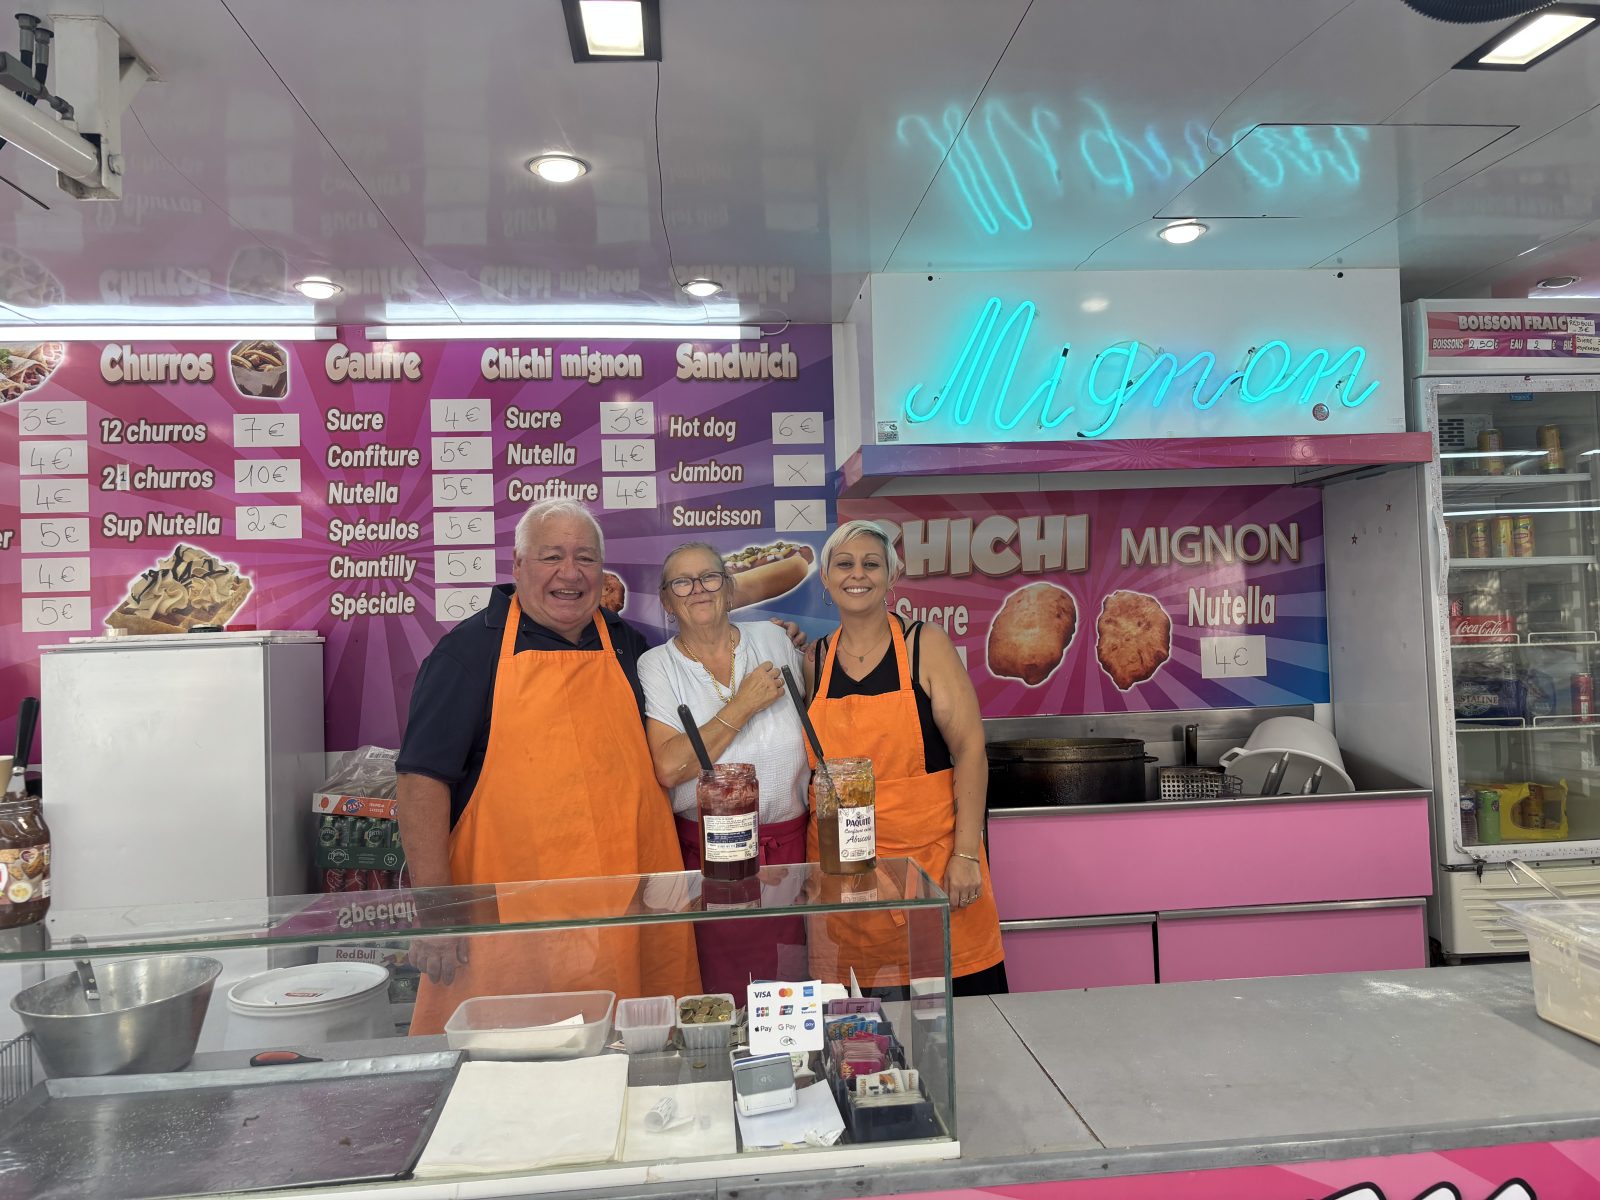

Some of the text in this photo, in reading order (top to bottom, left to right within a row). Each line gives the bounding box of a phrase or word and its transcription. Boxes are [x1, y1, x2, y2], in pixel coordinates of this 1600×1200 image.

[1458, 315, 1585, 331] BOISSON FRAIC
[1432, 338, 1464, 349] BOISSONS
[1510, 338, 1523, 350] EAU
[1563, 337, 1573, 351] BIE
[100, 343, 214, 382] Churros
[325, 343, 421, 382] Gaufre
[481, 345, 643, 384] Chichi mignon
[676, 343, 798, 380] Sandwich
[905, 296, 1380, 437] Mignon
[326, 408, 384, 431] Sucre
[506, 407, 562, 429] Sucre
[670, 416, 736, 442] Hot dog
[101, 420, 206, 443] 12 churros
[327, 446, 420, 468] Confiture
[507, 443, 575, 465] Nutella
[102, 464, 214, 490] 21 churros
[670, 461, 743, 483] Jambon
[328, 482, 398, 504] Nutella
[508, 479, 598, 501] Confiture
[103, 513, 220, 542] Sup Nutella
[672, 505, 762, 527] Saucisson
[329, 518, 419, 546] Spéculos
[1121, 522, 1301, 567] MIGNON
[330, 556, 416, 581] Chantilly
[330, 592, 415, 620] Spéciale
[1188, 585, 1276, 627] Nutella
[760, 1025, 773, 1033] Pay
[785, 1023, 797, 1032] Pay
